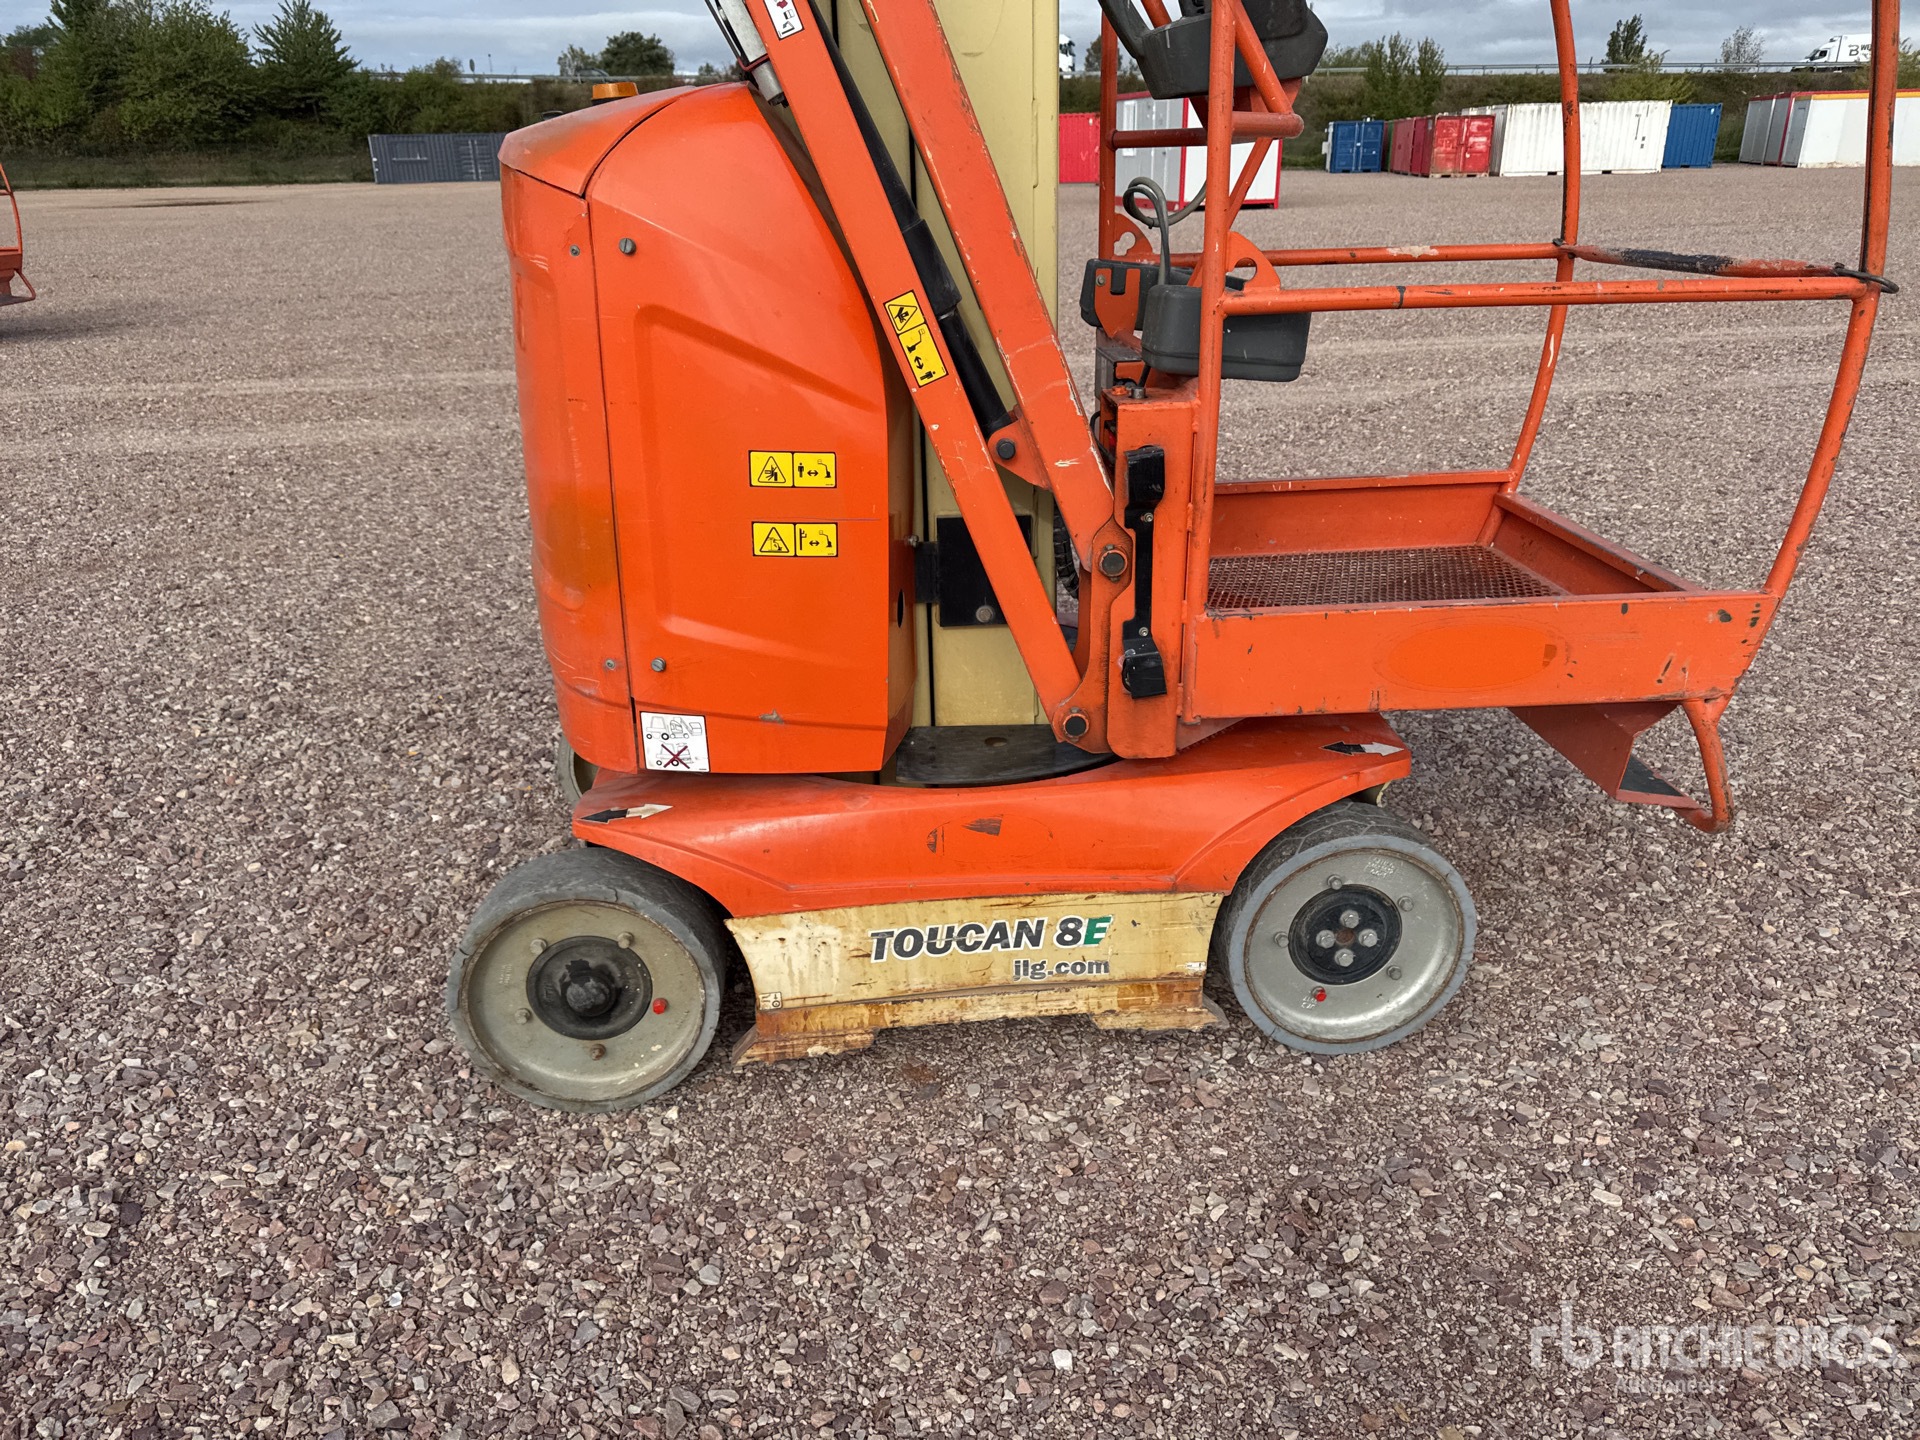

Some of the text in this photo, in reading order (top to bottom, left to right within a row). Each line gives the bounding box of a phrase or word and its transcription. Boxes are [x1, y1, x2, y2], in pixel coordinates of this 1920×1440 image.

[869, 915, 1112, 962] TOUCAN 8E
[1013, 958, 1110, 981] jlg.com
